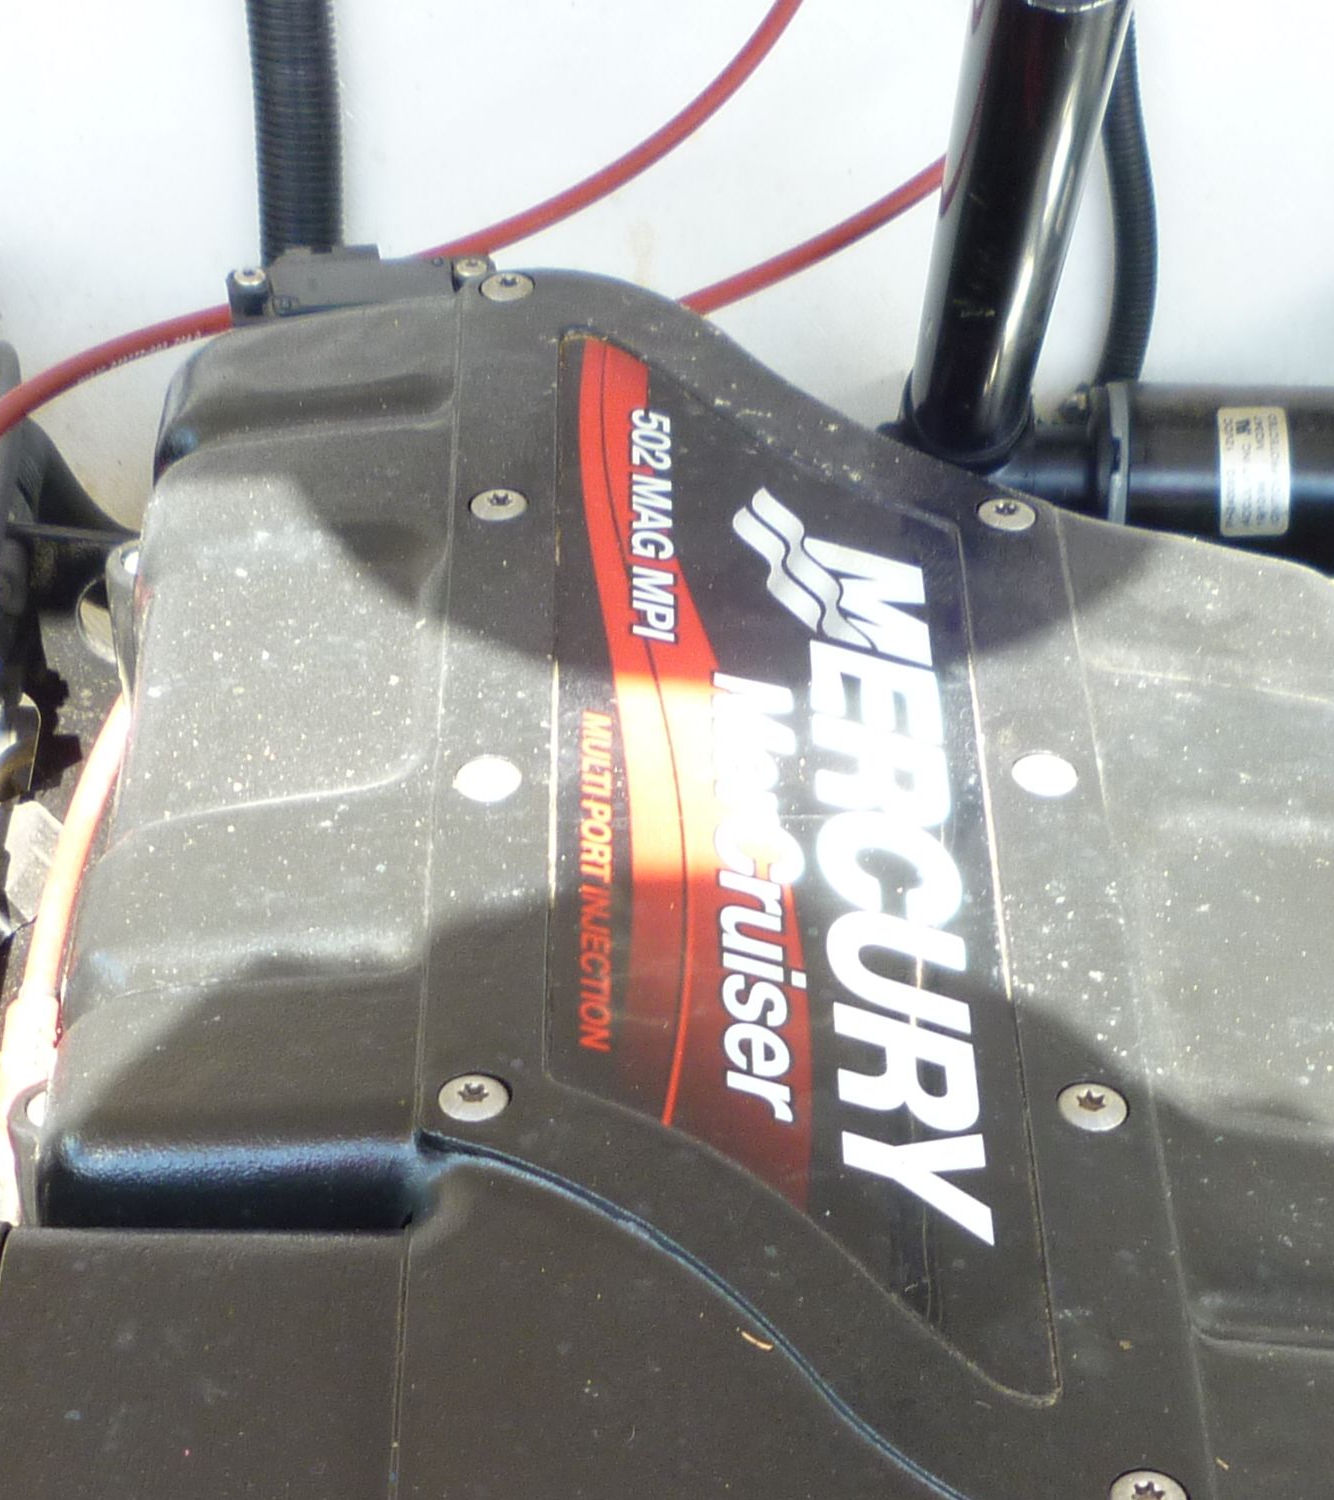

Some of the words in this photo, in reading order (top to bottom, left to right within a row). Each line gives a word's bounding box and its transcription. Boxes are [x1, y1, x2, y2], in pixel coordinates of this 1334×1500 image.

[630, 408, 673, 472] 502
[631, 473, 675, 560] MAG
[631, 565, 677, 643] MPI
[579, 799, 613, 884] PORT
[805, 537, 995, 1247] MERCURY
[578, 885, 613, 1054] INJECTION
